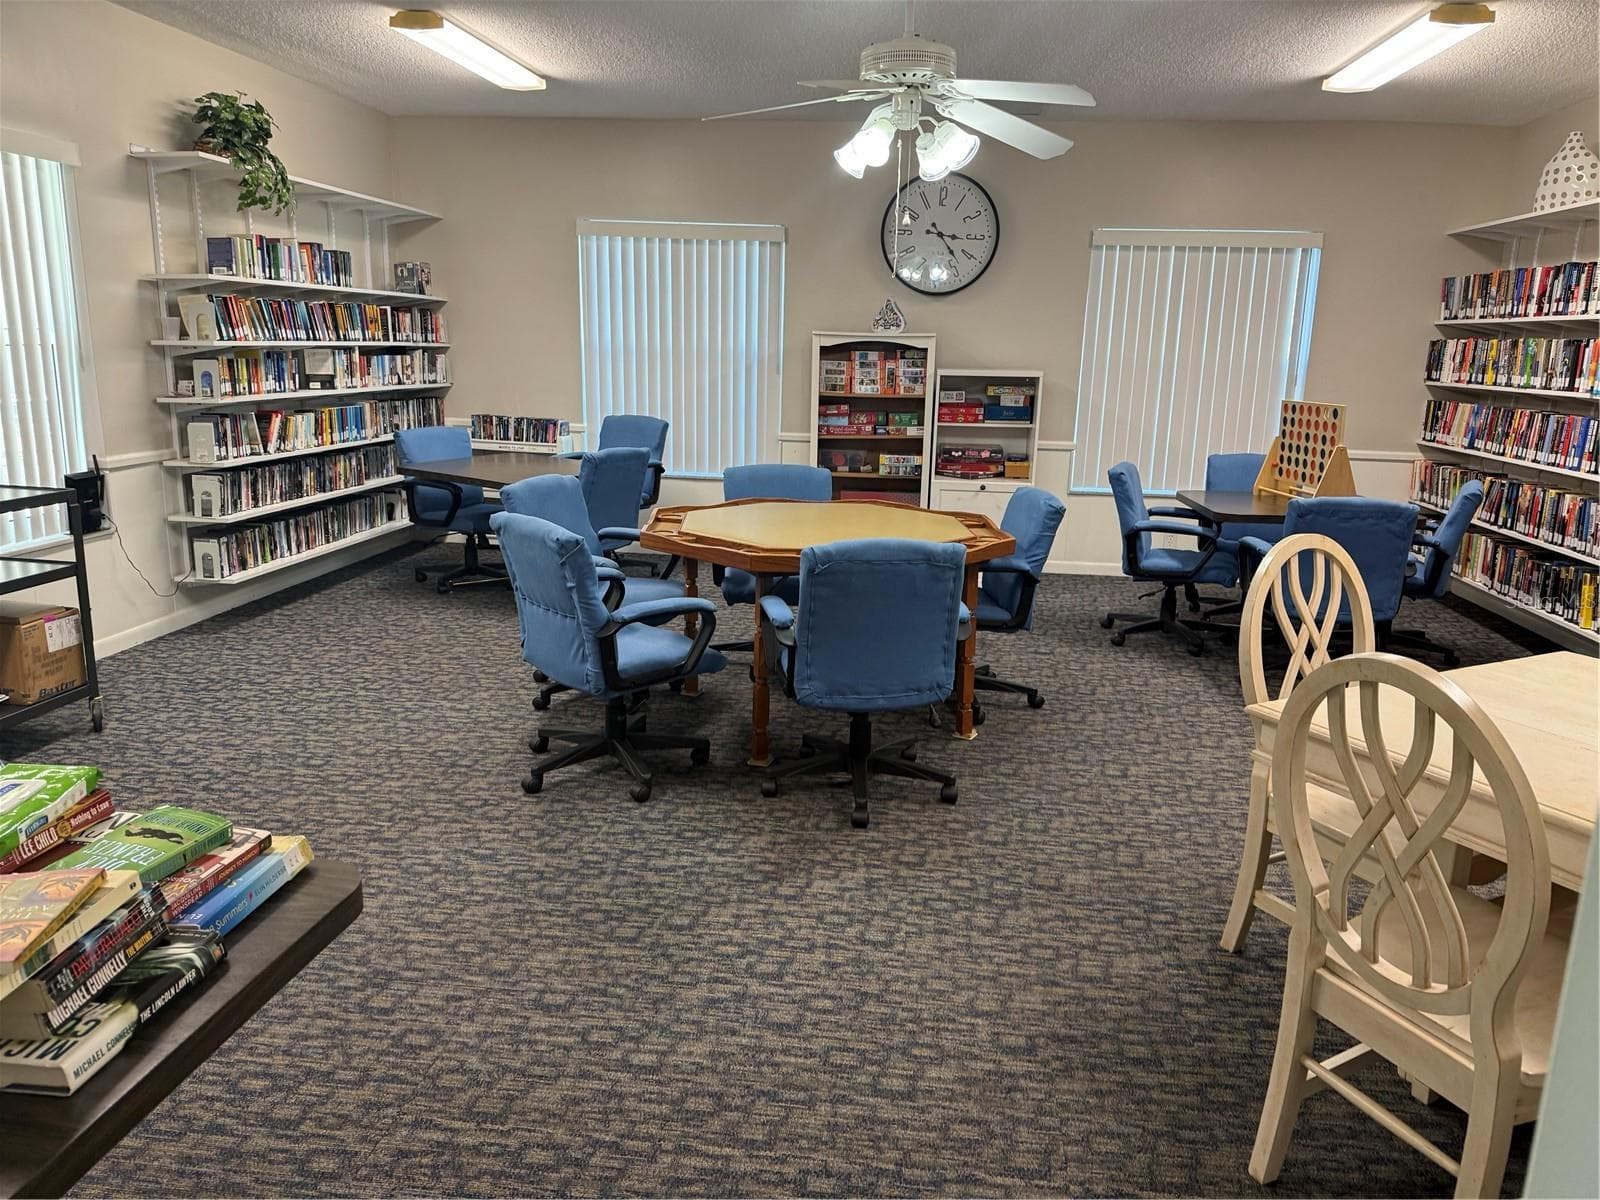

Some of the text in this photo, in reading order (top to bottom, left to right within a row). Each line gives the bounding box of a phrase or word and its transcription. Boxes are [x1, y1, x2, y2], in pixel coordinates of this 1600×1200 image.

[939, 186, 948, 206] 12
[963, 210, 982, 224] 2
[966, 233, 985, 241] 3
[961, 248, 977, 261] 4
[39, 678, 76, 698] Baxter
[70, 811, 93, 828] Nothing
[20, 840, 37, 859] LEE
[34, 827, 58, 850] CHILD
[83, 839, 168, 866] FRANCIS
[216, 899, 249, 930] Summers
[48, 988, 90, 1029] MICHAEL
[87, 951, 129, 996] CONNELLY
[140, 1007, 152, 1024] THE
[152, 986, 177, 1015] LINCOLN
[176, 968, 197, 993] LAWYER
[73, 1047, 106, 1080] MICHAEL
